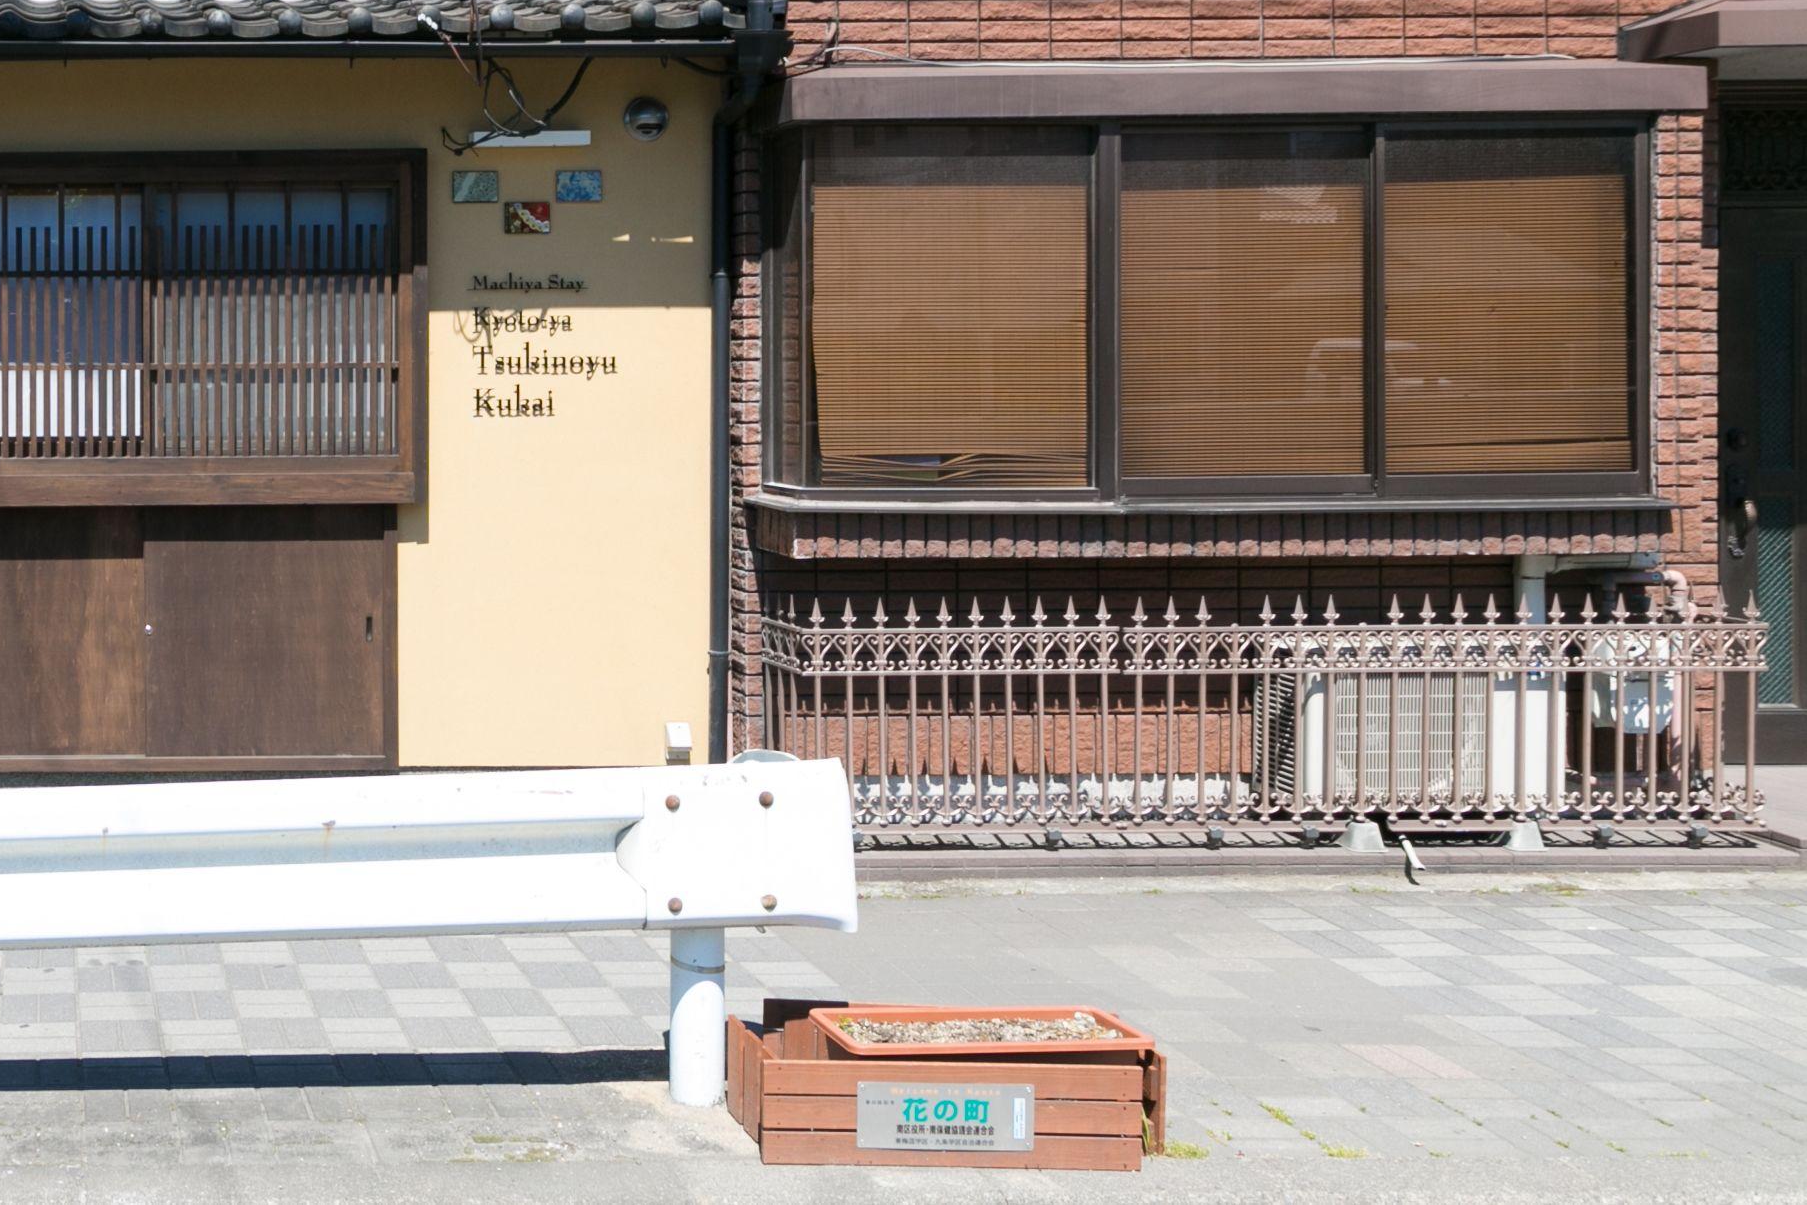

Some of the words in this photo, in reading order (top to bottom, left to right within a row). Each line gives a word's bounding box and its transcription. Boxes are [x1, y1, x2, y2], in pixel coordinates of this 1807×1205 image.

[472, 272, 542, 293] Machiya
[548, 274, 585, 293] Stay
[472, 306, 572, 335] Kyoto-ya
[472, 342, 617, 378] Tsukinoyu
[473, 384, 556, 415] Kukai
[902, 1097, 990, 1124] 花の町
